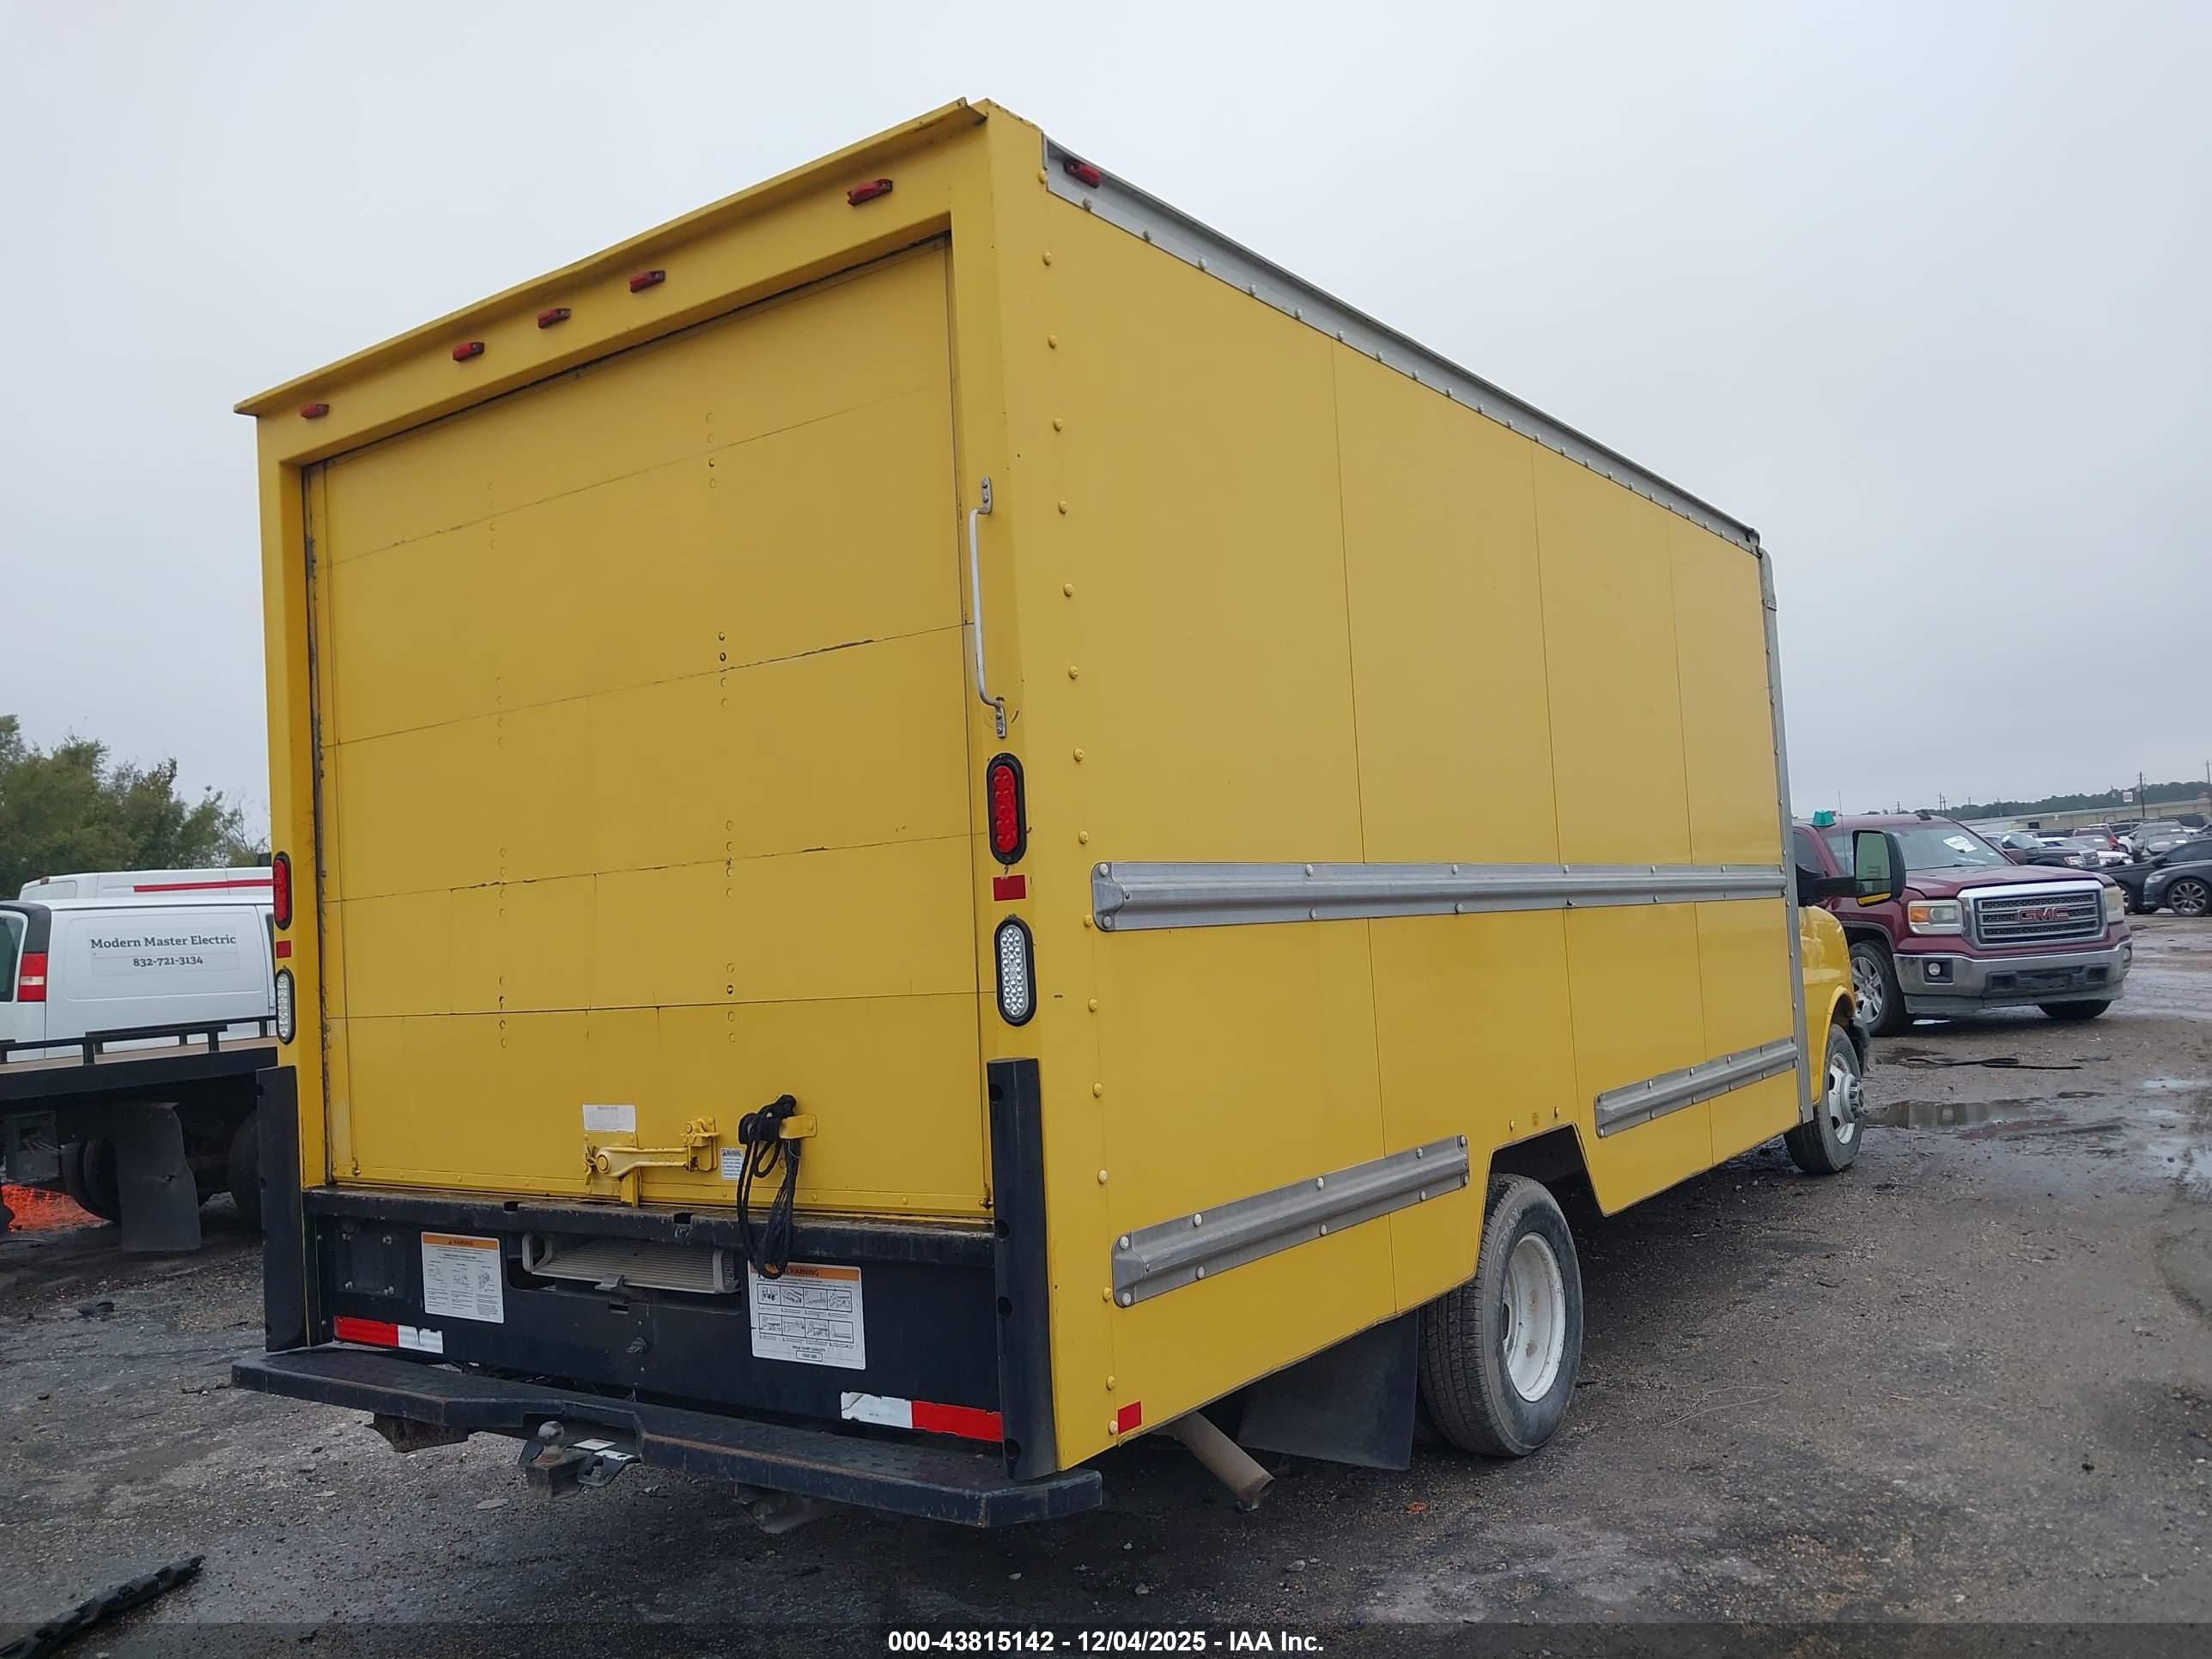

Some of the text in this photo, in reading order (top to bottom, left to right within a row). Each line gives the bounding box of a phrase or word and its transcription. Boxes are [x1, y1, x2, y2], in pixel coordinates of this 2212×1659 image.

[2017, 906, 2069, 922] GMC
[90, 934, 237, 949] Modern Master Electric
[133, 955, 204, 968] 832-721-3134
[790, 1267, 819, 1277] WARNING
